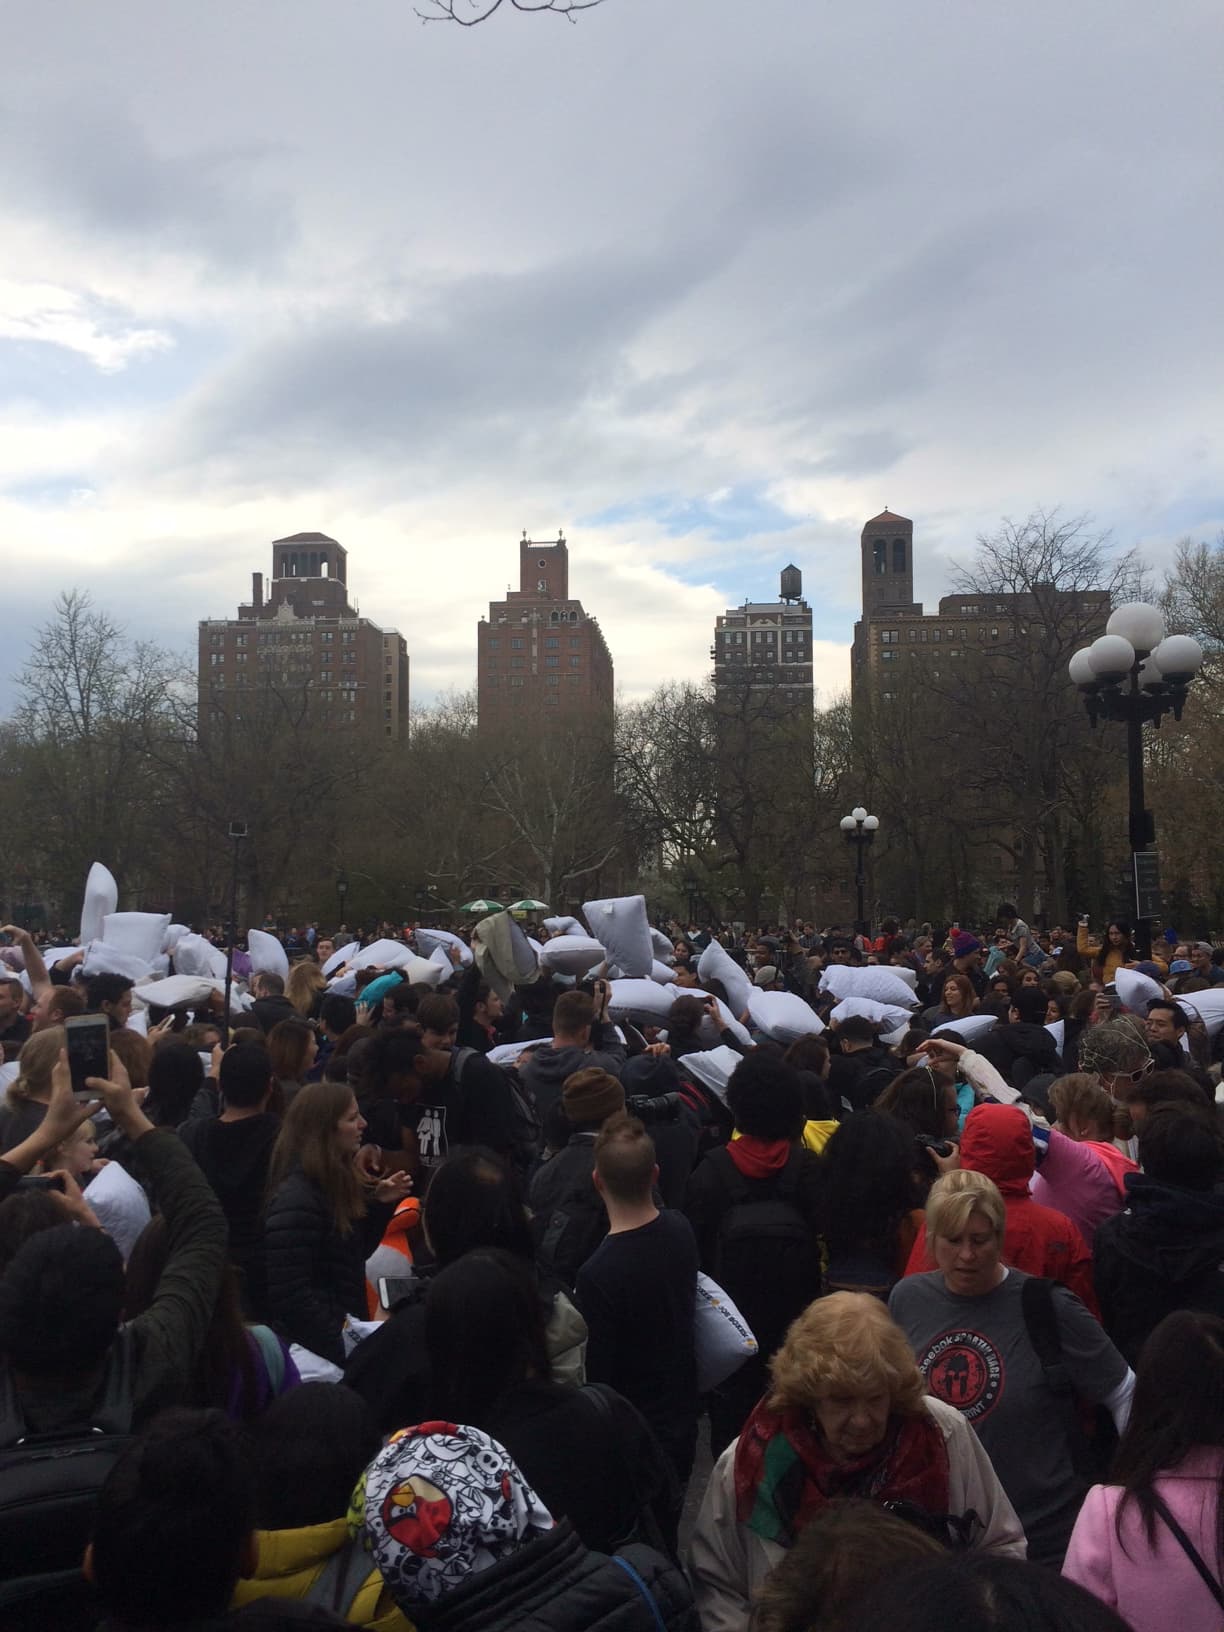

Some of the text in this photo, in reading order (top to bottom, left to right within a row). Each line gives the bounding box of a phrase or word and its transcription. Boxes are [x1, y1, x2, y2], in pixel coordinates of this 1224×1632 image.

[718, 1306, 749, 1338] JOE BOXER
[919, 1333, 1001, 1379] Reebok SPARTAN RACE
